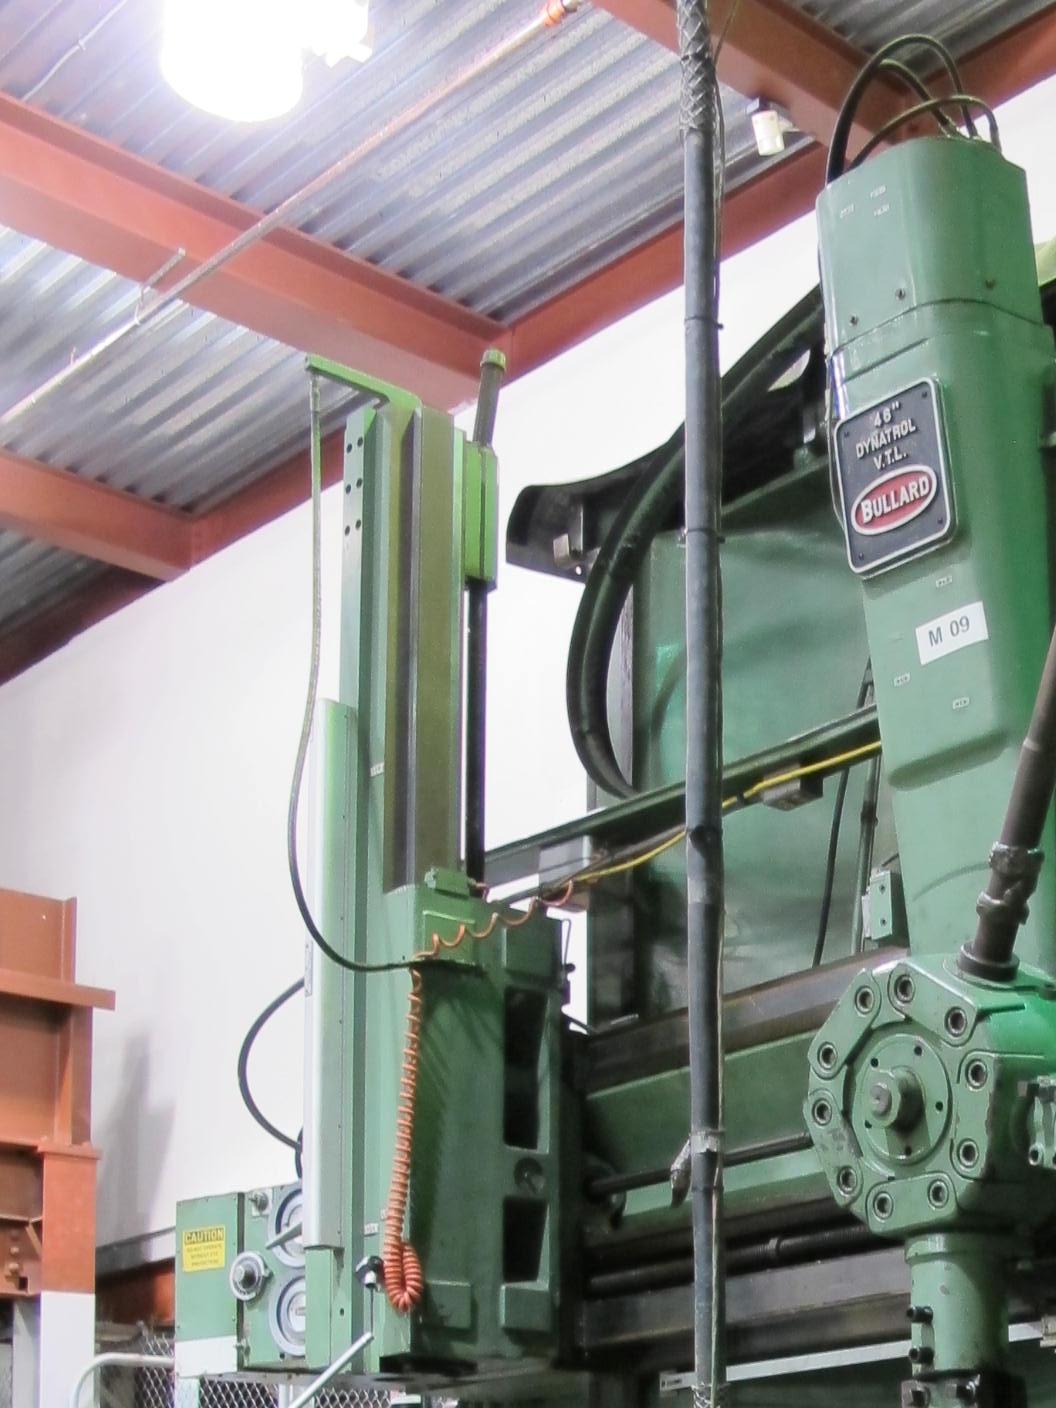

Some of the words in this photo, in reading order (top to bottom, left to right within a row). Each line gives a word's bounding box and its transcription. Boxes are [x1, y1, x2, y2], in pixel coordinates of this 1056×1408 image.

[856, 418, 916, 459] DYNATROL
[873, 446, 907, 470] V.T.L.
[861, 475, 930, 524] BULLARD
[928, 626, 943, 647] M
[949, 615, 970, 638] 09
[186, 1228, 224, 1244] CAUTION
